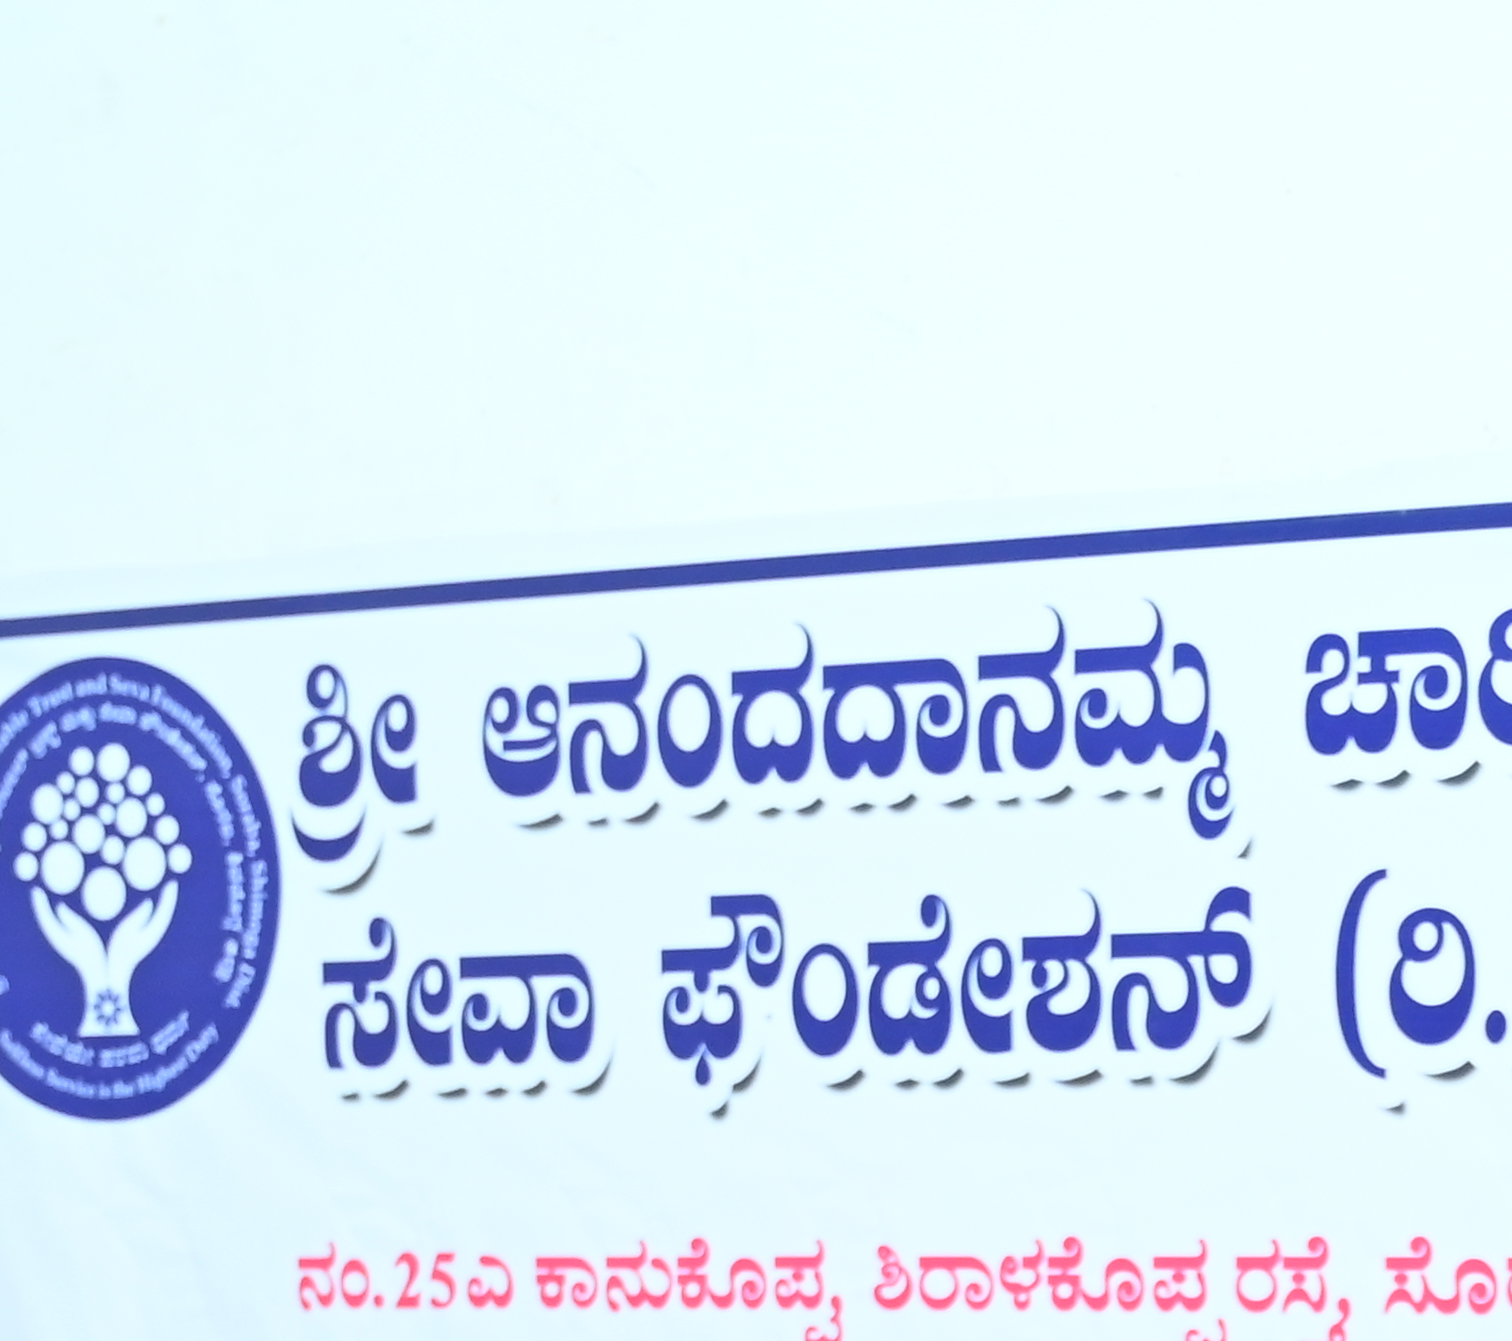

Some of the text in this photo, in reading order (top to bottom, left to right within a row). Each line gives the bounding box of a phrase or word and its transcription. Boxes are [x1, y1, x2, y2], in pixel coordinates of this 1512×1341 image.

[296, 665, 417, 862] ಶ್ರೀ
[482, 598, 1232, 840] ಆನಂದದಾನಮ್ಮ
[323, 918, 595, 1069] ಸೇವಾ
[661, 886, 1252, 1085] ಫೌಂಡೇಶನ್
[299, 1240, 514, 1310] ನಂ.25ಎ
